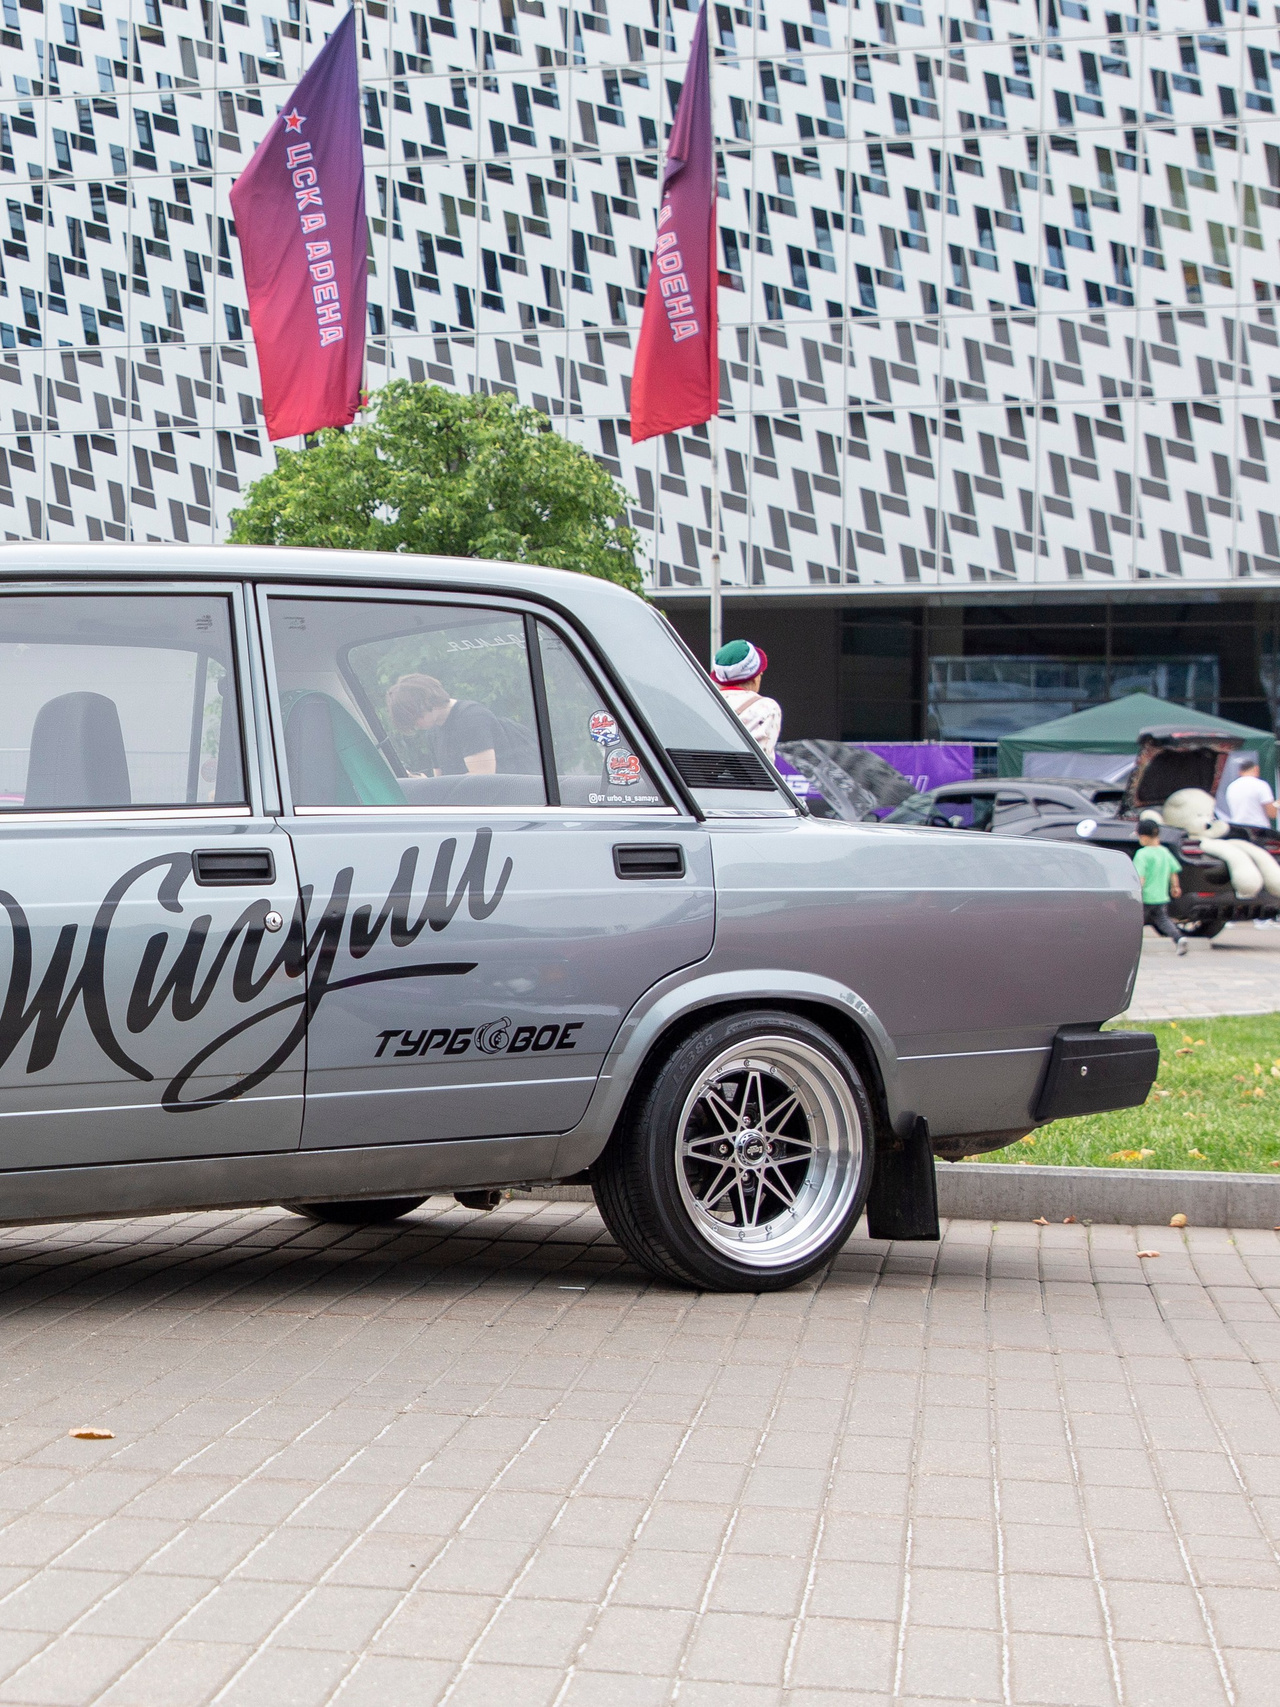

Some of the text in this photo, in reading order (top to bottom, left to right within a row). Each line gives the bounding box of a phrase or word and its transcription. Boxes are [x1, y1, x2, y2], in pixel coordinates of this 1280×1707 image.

[287, 141, 344, 347] ЦСКА АРЕНА
[656, 231, 700, 343] АРЕНА
